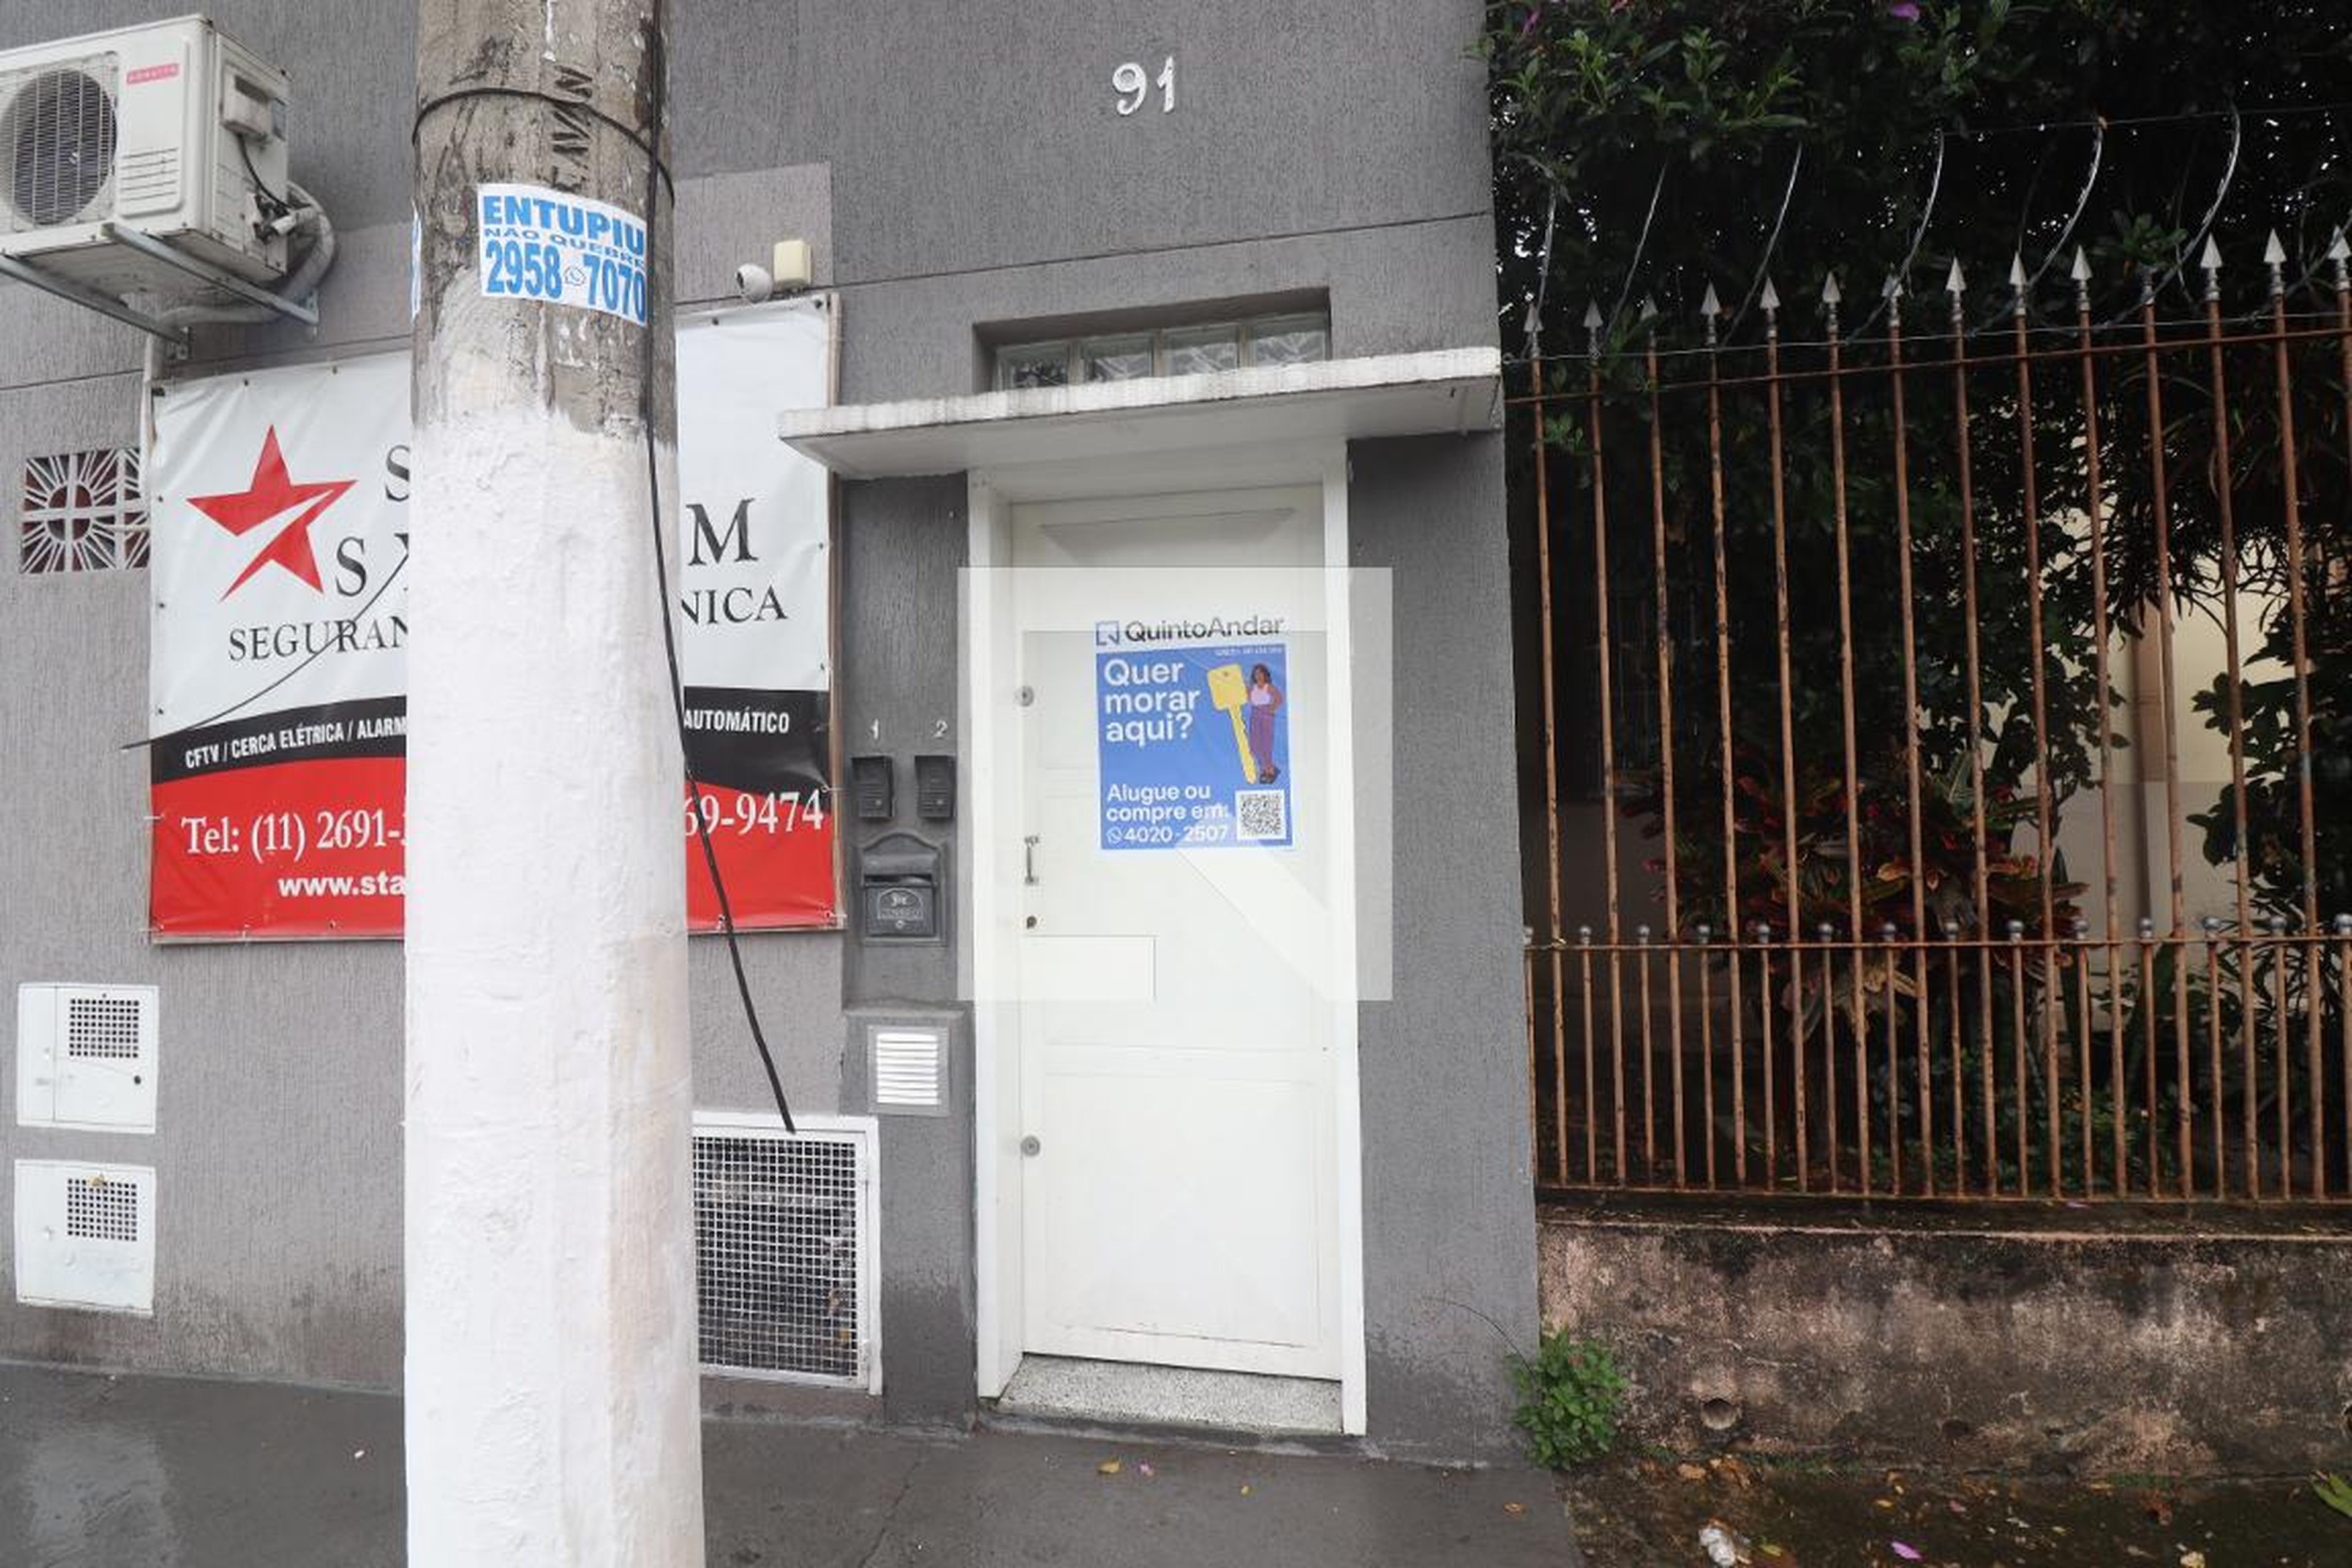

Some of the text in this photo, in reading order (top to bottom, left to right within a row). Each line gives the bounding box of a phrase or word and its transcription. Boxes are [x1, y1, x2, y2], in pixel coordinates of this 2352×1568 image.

[1112, 55, 1175, 116] 91
[483, 195, 645, 256] ENTUPIU
[486, 239, 646, 323] 2958 7070
[1125, 616, 1283, 643] QuintoAndar
[1104, 659, 1185, 686] Quer
[1105, 690, 1200, 714] morar
[186, 745, 219, 768] CFTV
[232, 733, 276, 758] CERCA
[279, 722, 344, 748] ELÉTRICA
[684, 706, 790, 733] AUTOMÁTICO
[1106, 713, 1194, 747] aqui?
[1107, 784, 1210, 806] Alugue ou
[1106, 805, 1186, 824] compre
[181, 816, 239, 853] Tel:
[251, 812, 306, 864] (11)
[316, 809, 406, 849] 2691-
